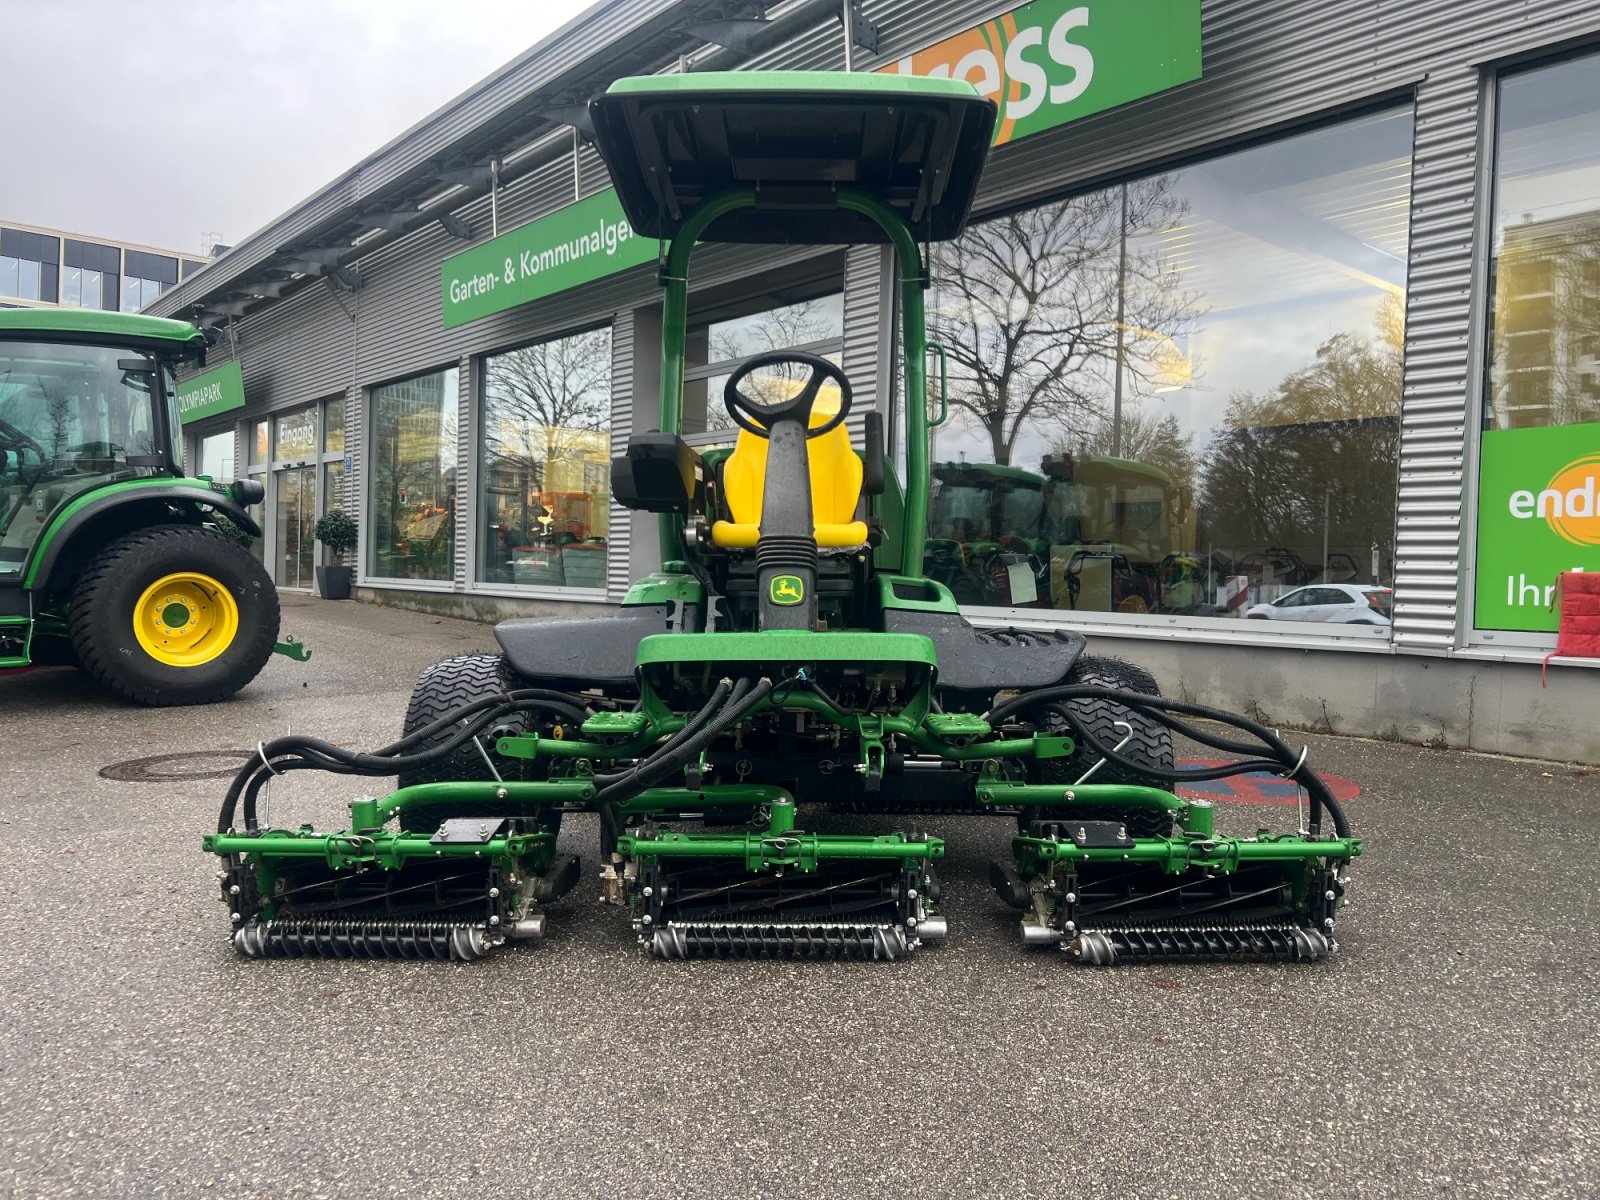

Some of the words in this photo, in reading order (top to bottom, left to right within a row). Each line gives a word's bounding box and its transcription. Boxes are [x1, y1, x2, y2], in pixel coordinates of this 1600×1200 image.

[898, 7, 1094, 119] ess
[450, 272, 500, 304] Garten-
[504, 257, 516, 285] &
[280, 423, 314, 447] Eingang
[1508, 476, 1600, 519] end
